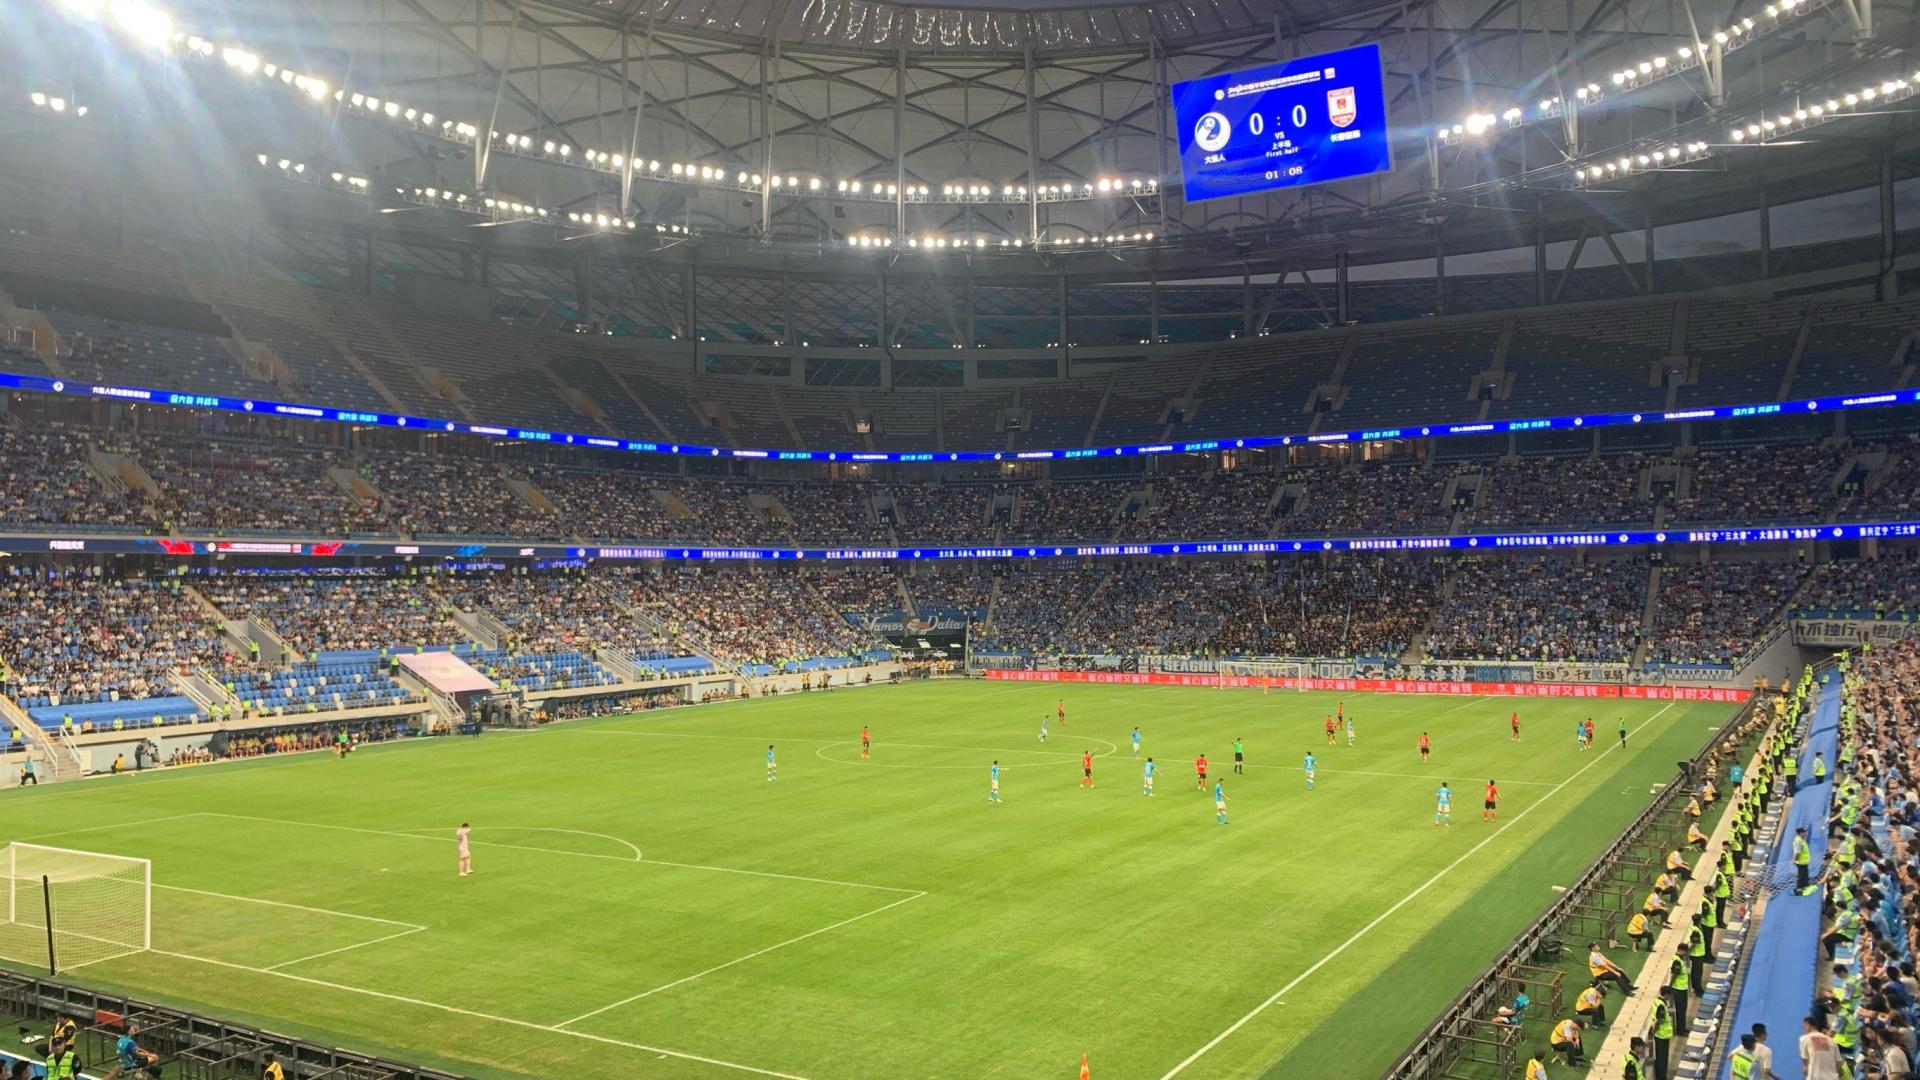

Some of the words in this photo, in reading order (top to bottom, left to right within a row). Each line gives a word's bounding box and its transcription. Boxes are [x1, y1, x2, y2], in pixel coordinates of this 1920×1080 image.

[1250, 112, 1264, 136] 0
[1292, 104, 1307, 128] 0
[1274, 131, 1285, 140] VS
[1265, 170, 1279, 180] 01
[1289, 166, 1303, 176] 08
